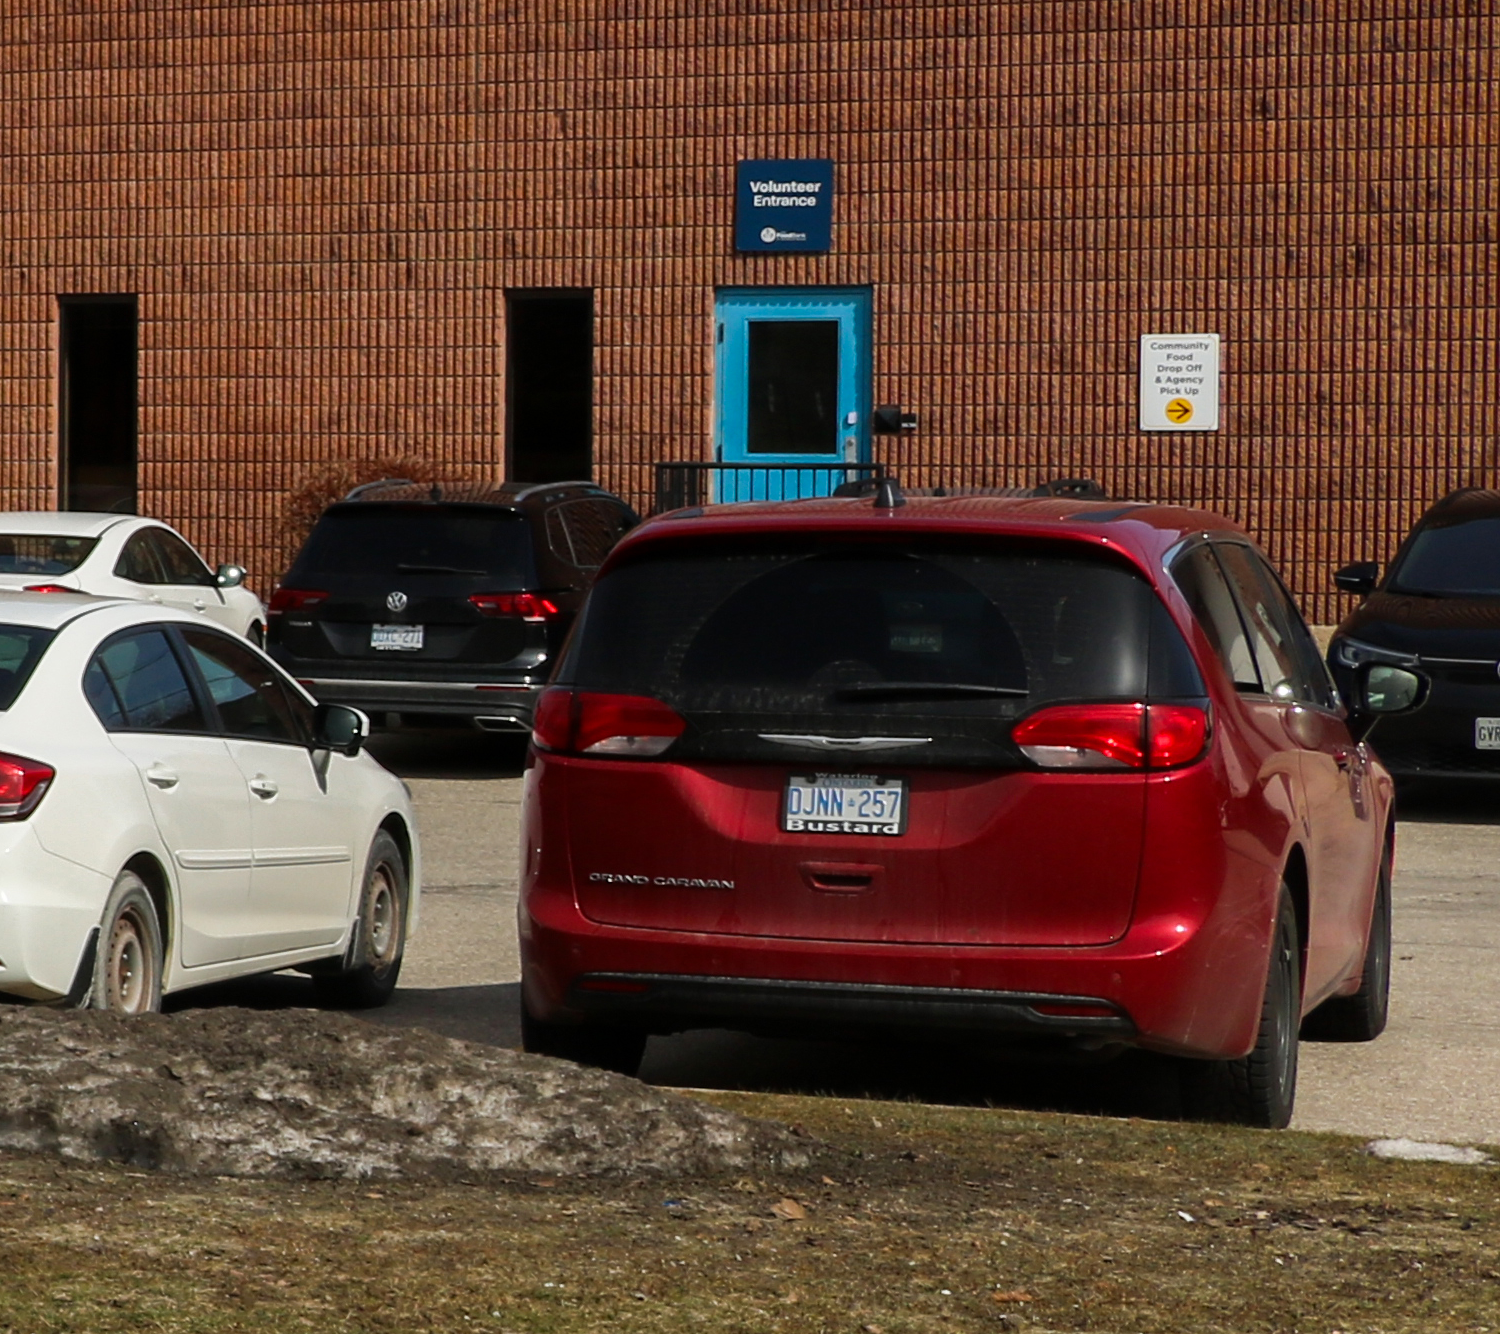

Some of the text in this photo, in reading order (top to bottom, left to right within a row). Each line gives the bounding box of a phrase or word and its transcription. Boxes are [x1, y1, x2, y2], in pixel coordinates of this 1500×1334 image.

[750, 180, 821, 193] Volunteer
[753, 195, 817, 207] Entrance
[1150, 341, 1210, 351] Community
[1166, 353, 1193, 361] Food
[1157, 364, 1202, 373] Drop Off
[1165, 376, 1204, 385] Agency
[1160, 387, 1199, 396] Pick Up
[788, 787, 900, 818] DJNN 257
[787, 819, 899, 834] Bustard
[589, 872, 735, 889] GRAND CARAVAN
